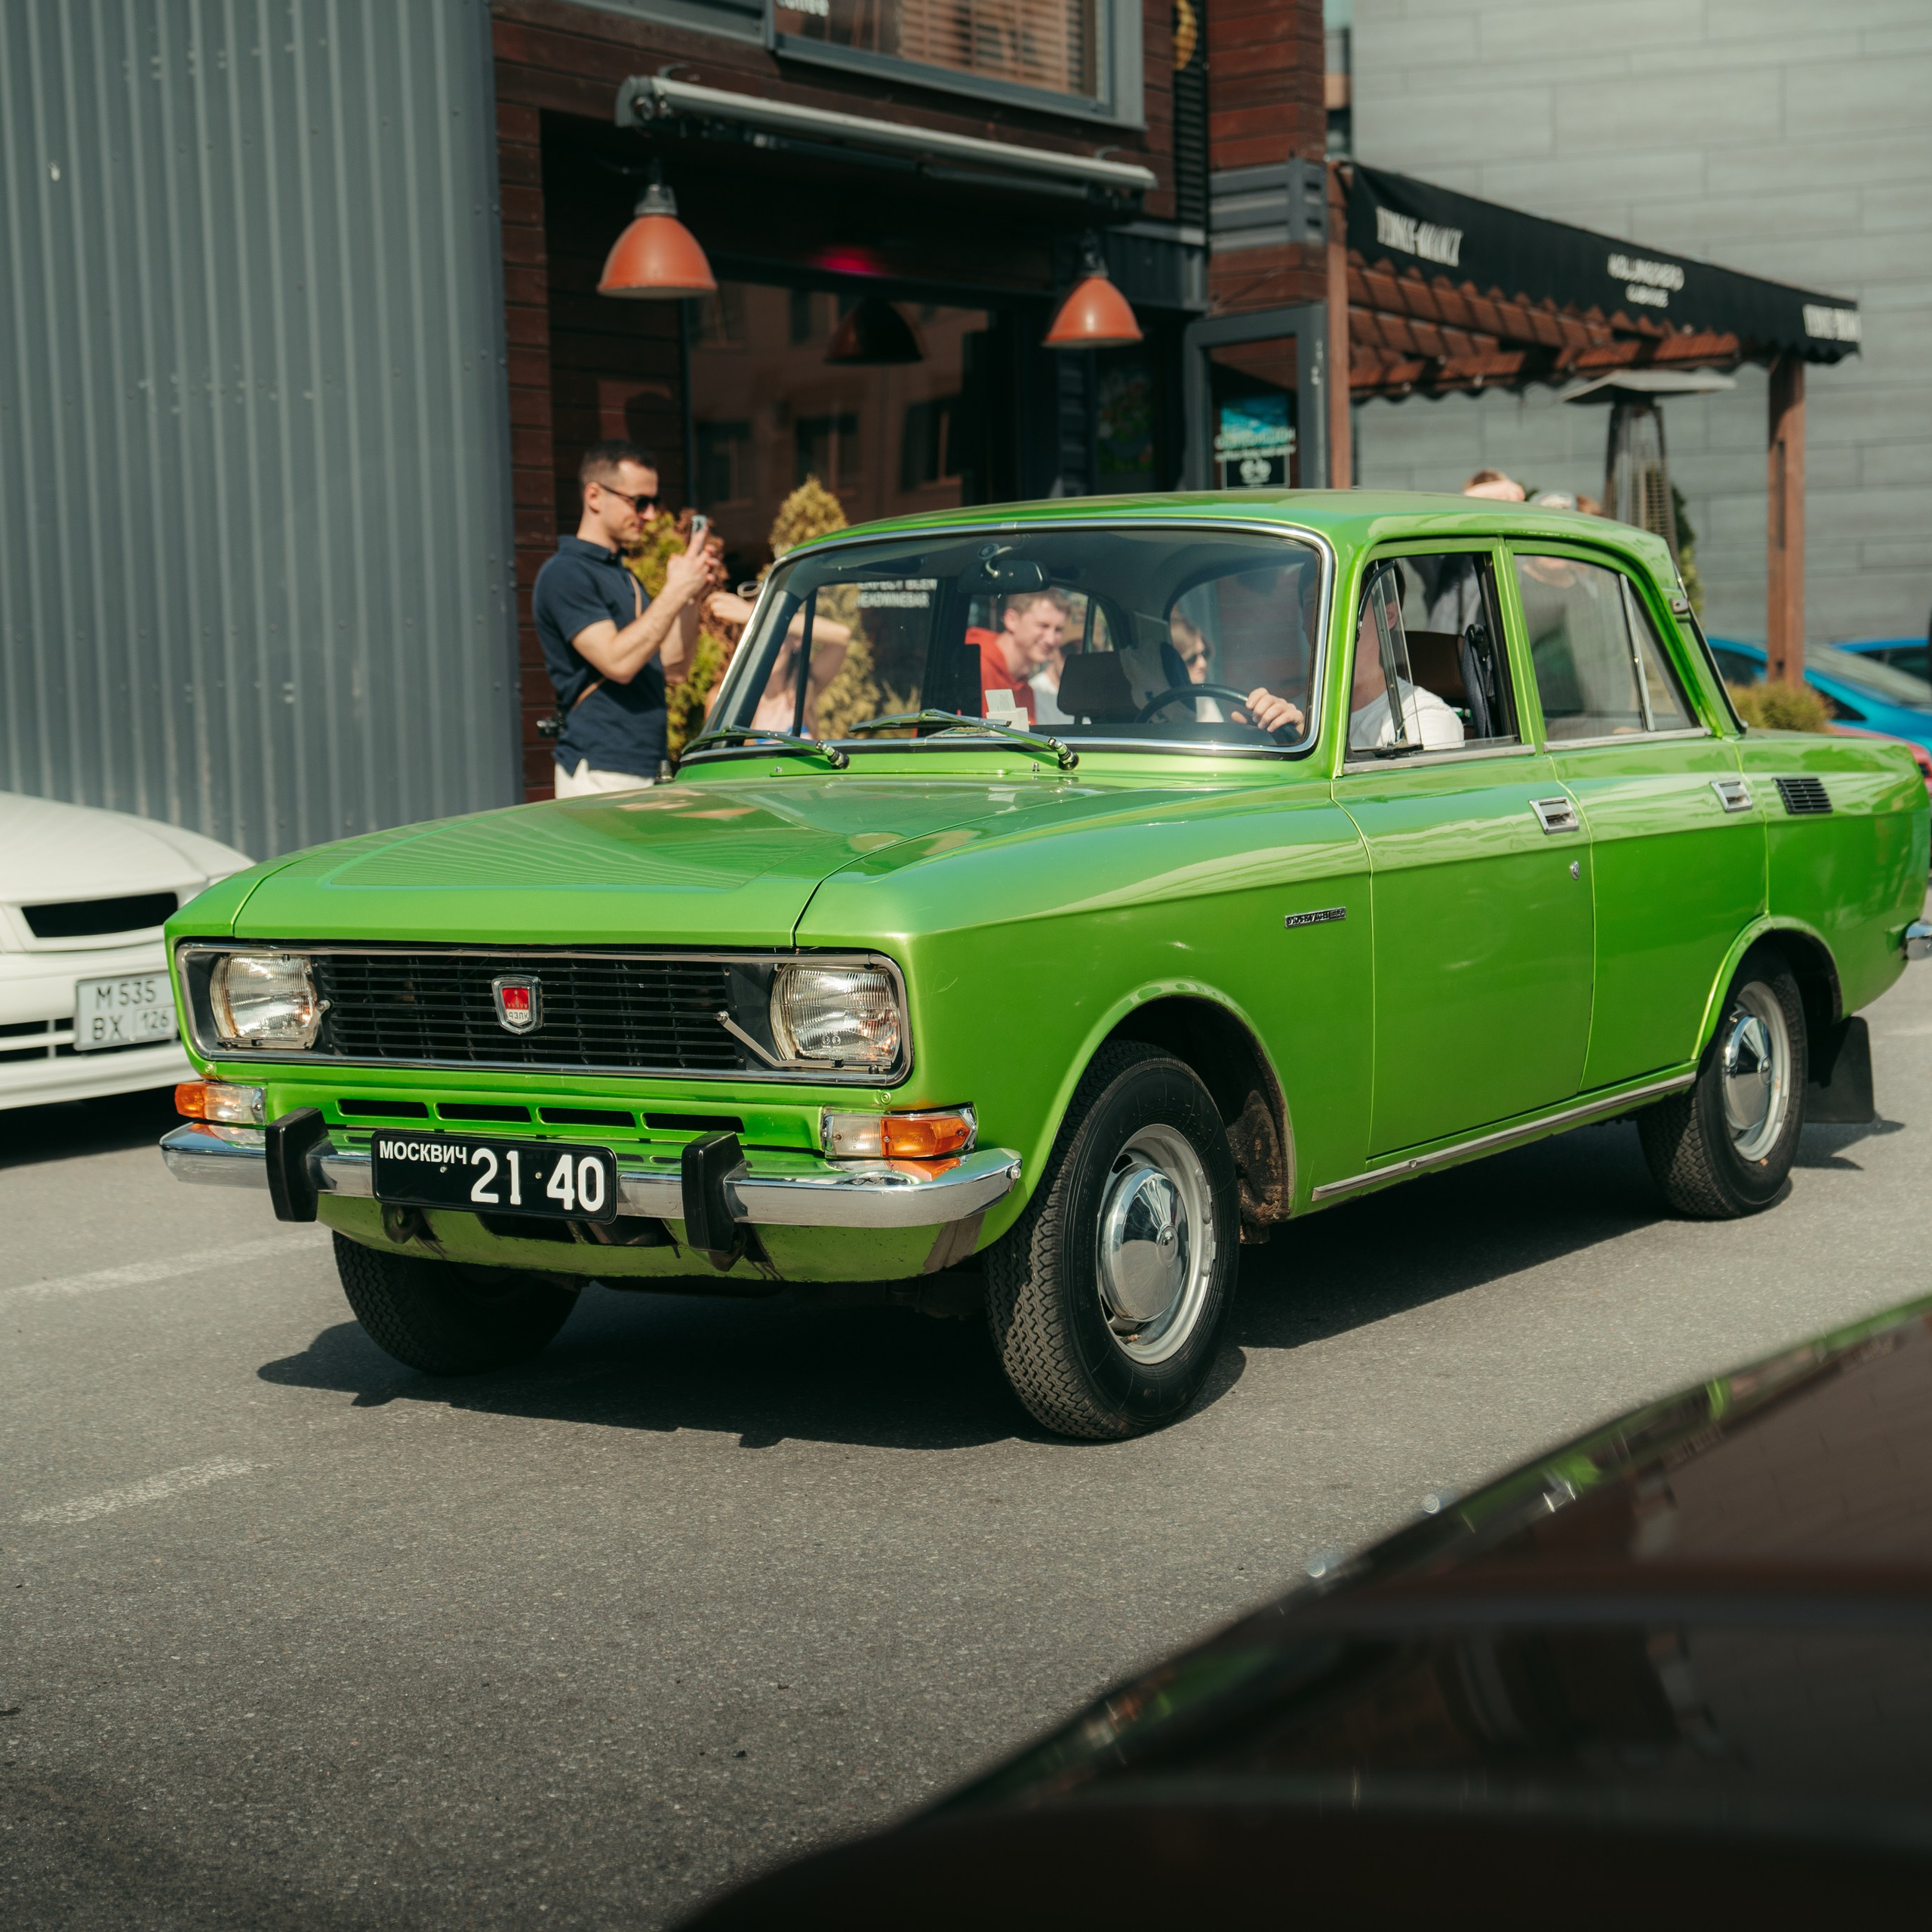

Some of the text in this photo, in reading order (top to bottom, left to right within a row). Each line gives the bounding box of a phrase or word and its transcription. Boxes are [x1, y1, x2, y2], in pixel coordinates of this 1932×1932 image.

[118, 980, 155, 1005] 535
[142, 1011, 169, 1029] 126
[379, 1140, 605, 1212] МОСКВИЧ 21 40
